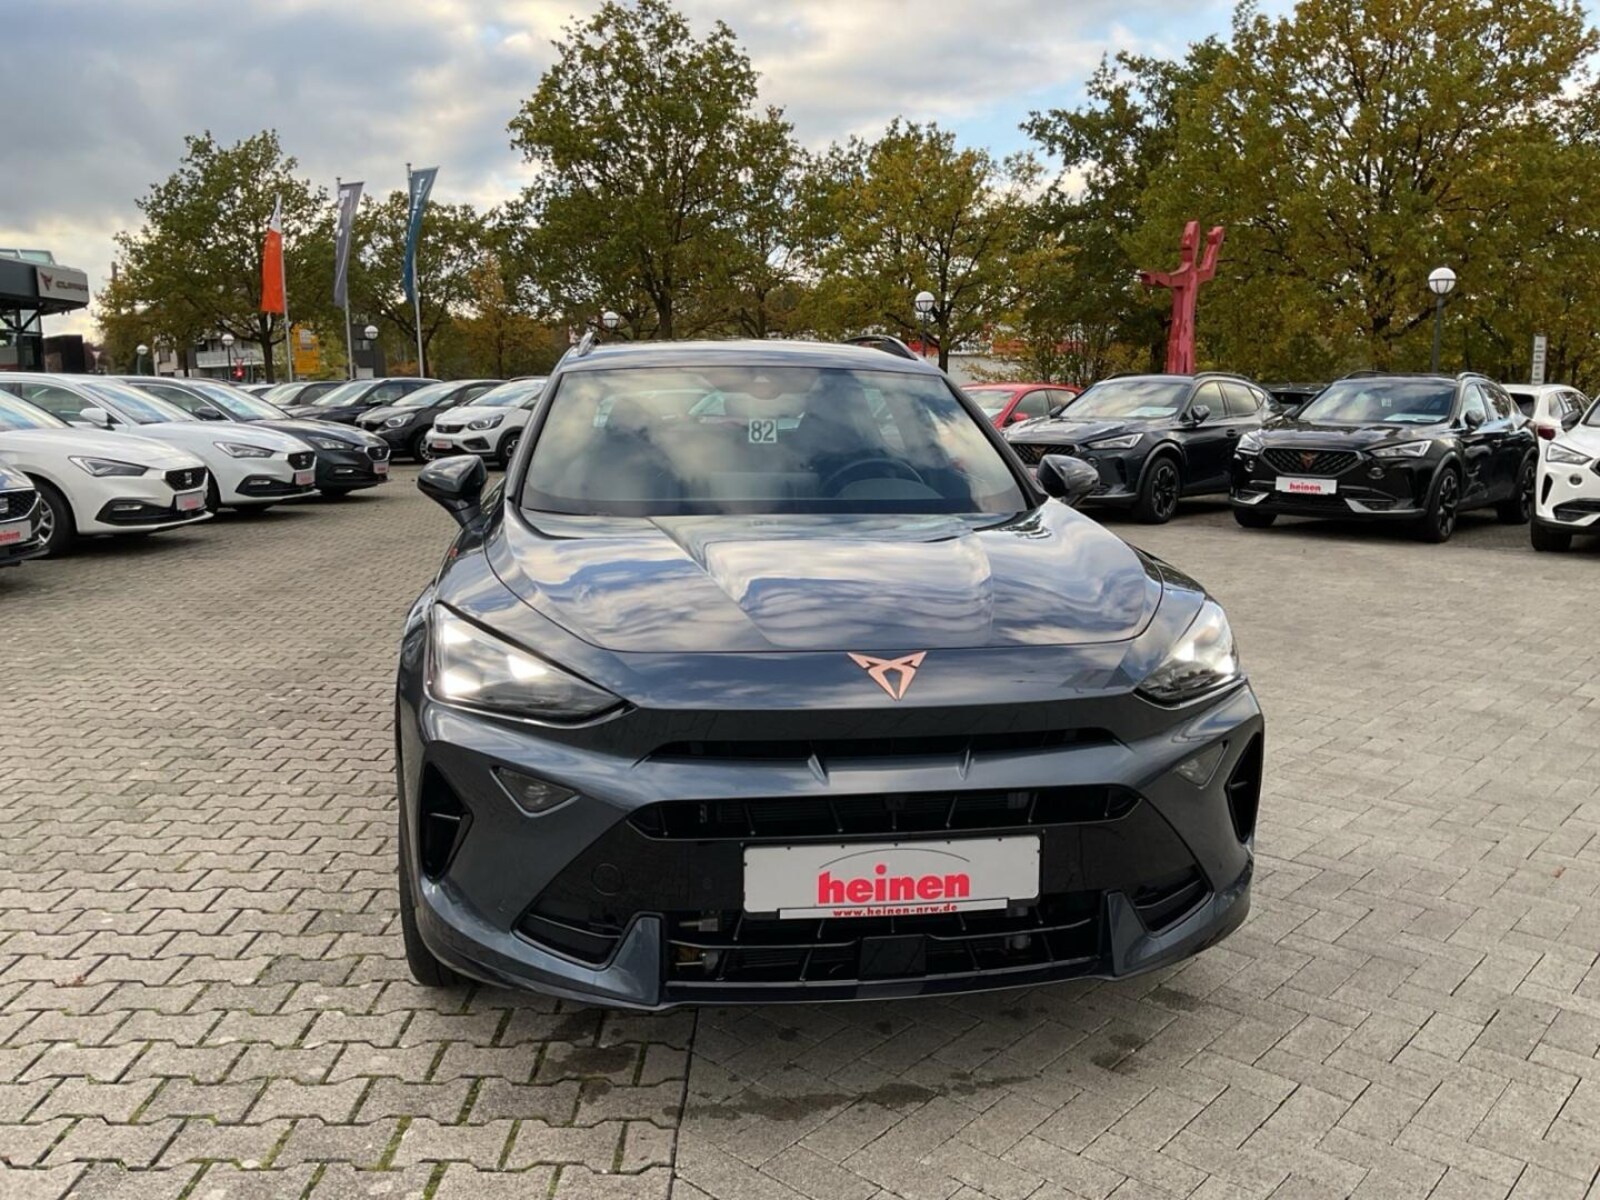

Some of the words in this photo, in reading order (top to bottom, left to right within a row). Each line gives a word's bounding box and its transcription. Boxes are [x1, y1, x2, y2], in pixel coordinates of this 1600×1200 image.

[751, 420, 774, 442] 82
[1289, 482, 1321, 492] heinen
[818, 864, 970, 904] heinen
[833, 903, 958, 917] www.heinen-nrw.de
